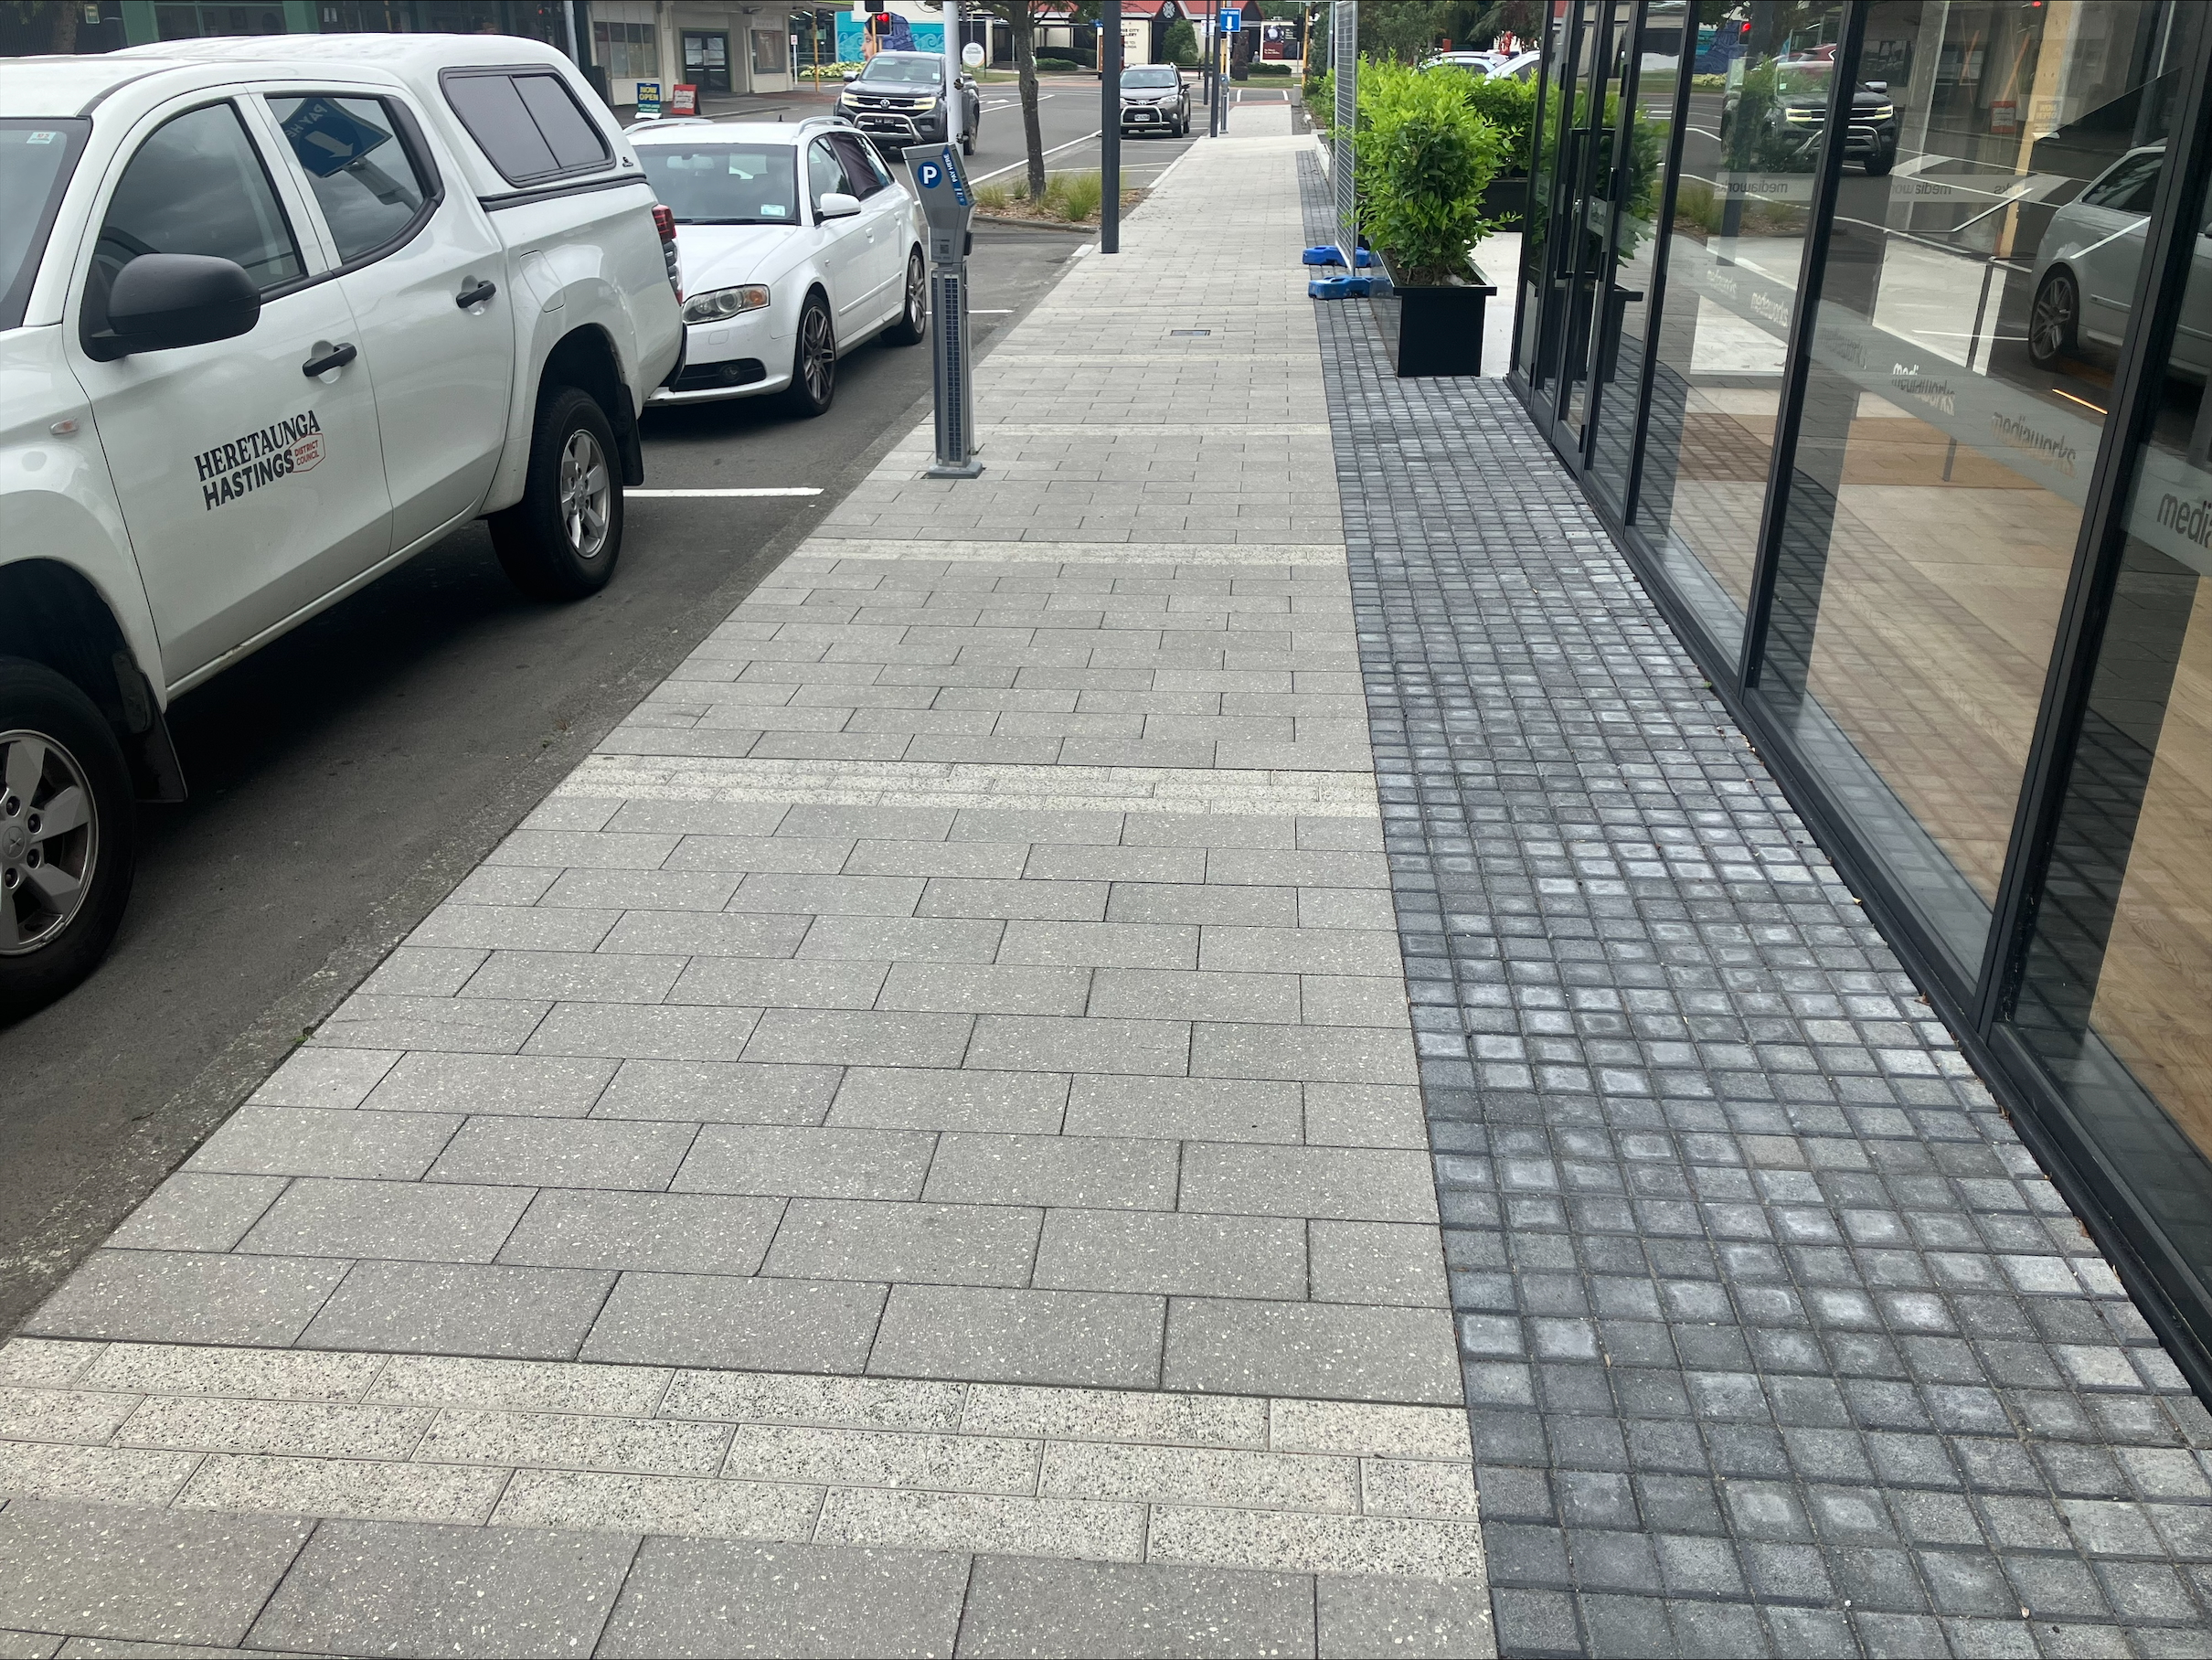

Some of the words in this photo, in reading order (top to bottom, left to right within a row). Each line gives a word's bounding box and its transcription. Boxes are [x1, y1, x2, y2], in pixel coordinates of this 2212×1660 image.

[942, 153, 953, 171] HERE
[922, 165, 938, 185] P
[949, 170, 959, 183] PAY
[194, 410, 321, 483] HERETAUNGA
[294, 440, 319, 457] DISTRICT
[295, 450, 320, 466] COUNCIL
[202, 449, 294, 511] HASTINGS
